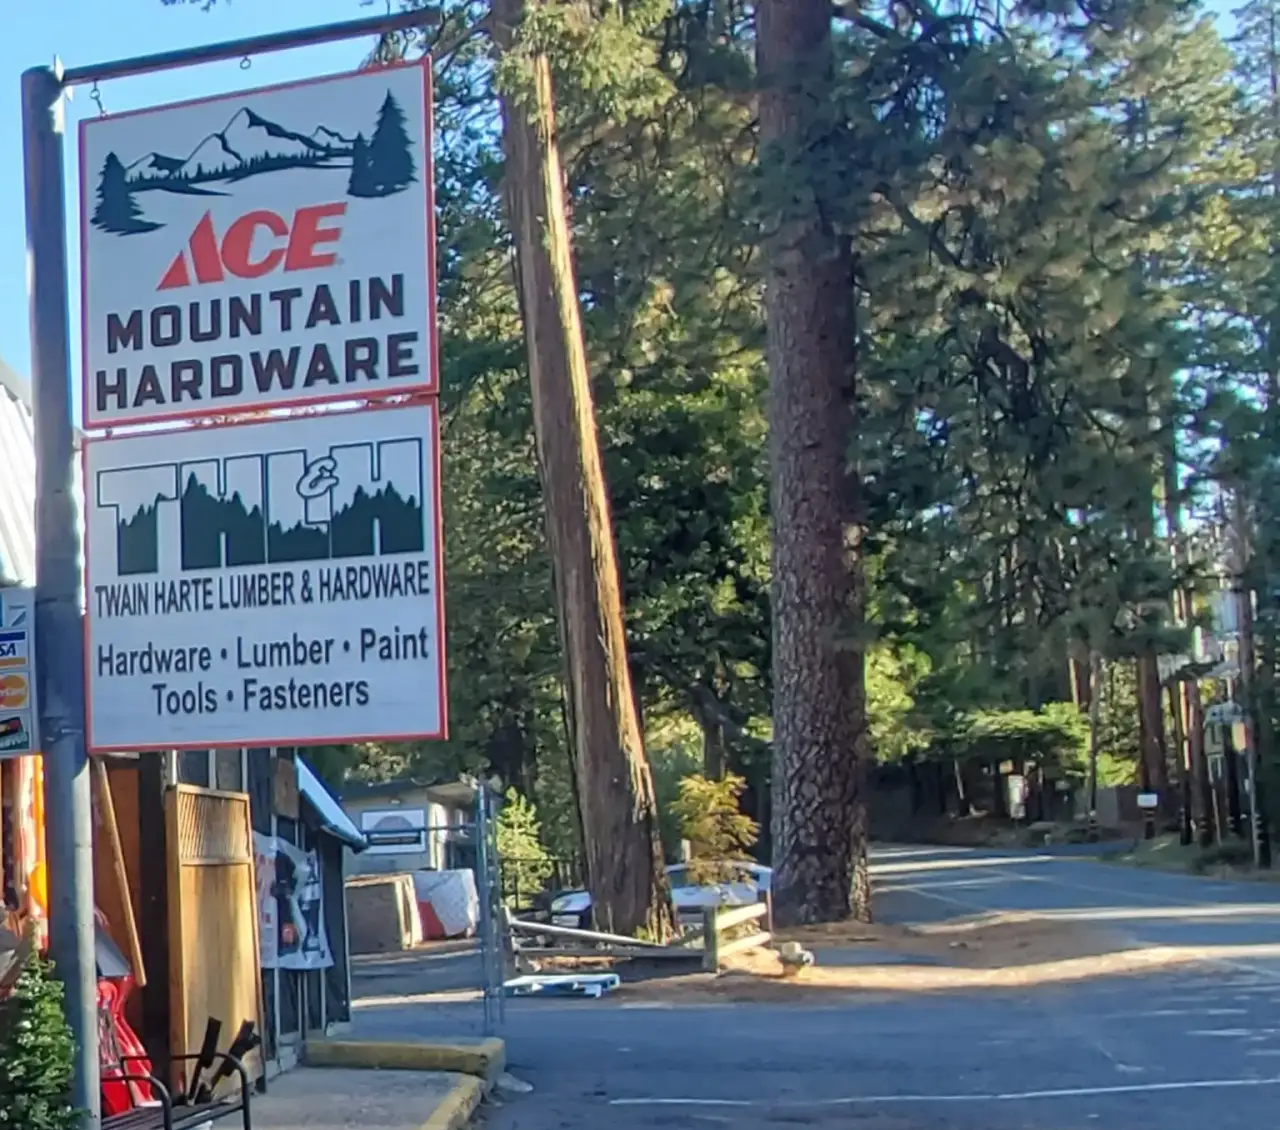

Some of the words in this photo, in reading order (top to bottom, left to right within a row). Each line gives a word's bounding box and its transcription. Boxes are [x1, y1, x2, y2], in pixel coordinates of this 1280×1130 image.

[155, 202, 348, 291] ACE
[106, 273, 405, 354] MOUNTAIN
[95, 331, 419, 412] HARDWARE
[95, 583, 149, 619] TWAIN
[154, 577, 214, 613] HARTE
[219, 570, 294, 609] LUMBER
[301, 573, 314, 602] &
[319, 560, 430, 601] HARDWARE
[97, 641, 211, 677] Hardware
[237, 632, 335, 669] Lumber
[360, 625, 429, 662] Paint
[152, 681, 218, 716] Tools
[243, 676, 370, 712] Fasteners
